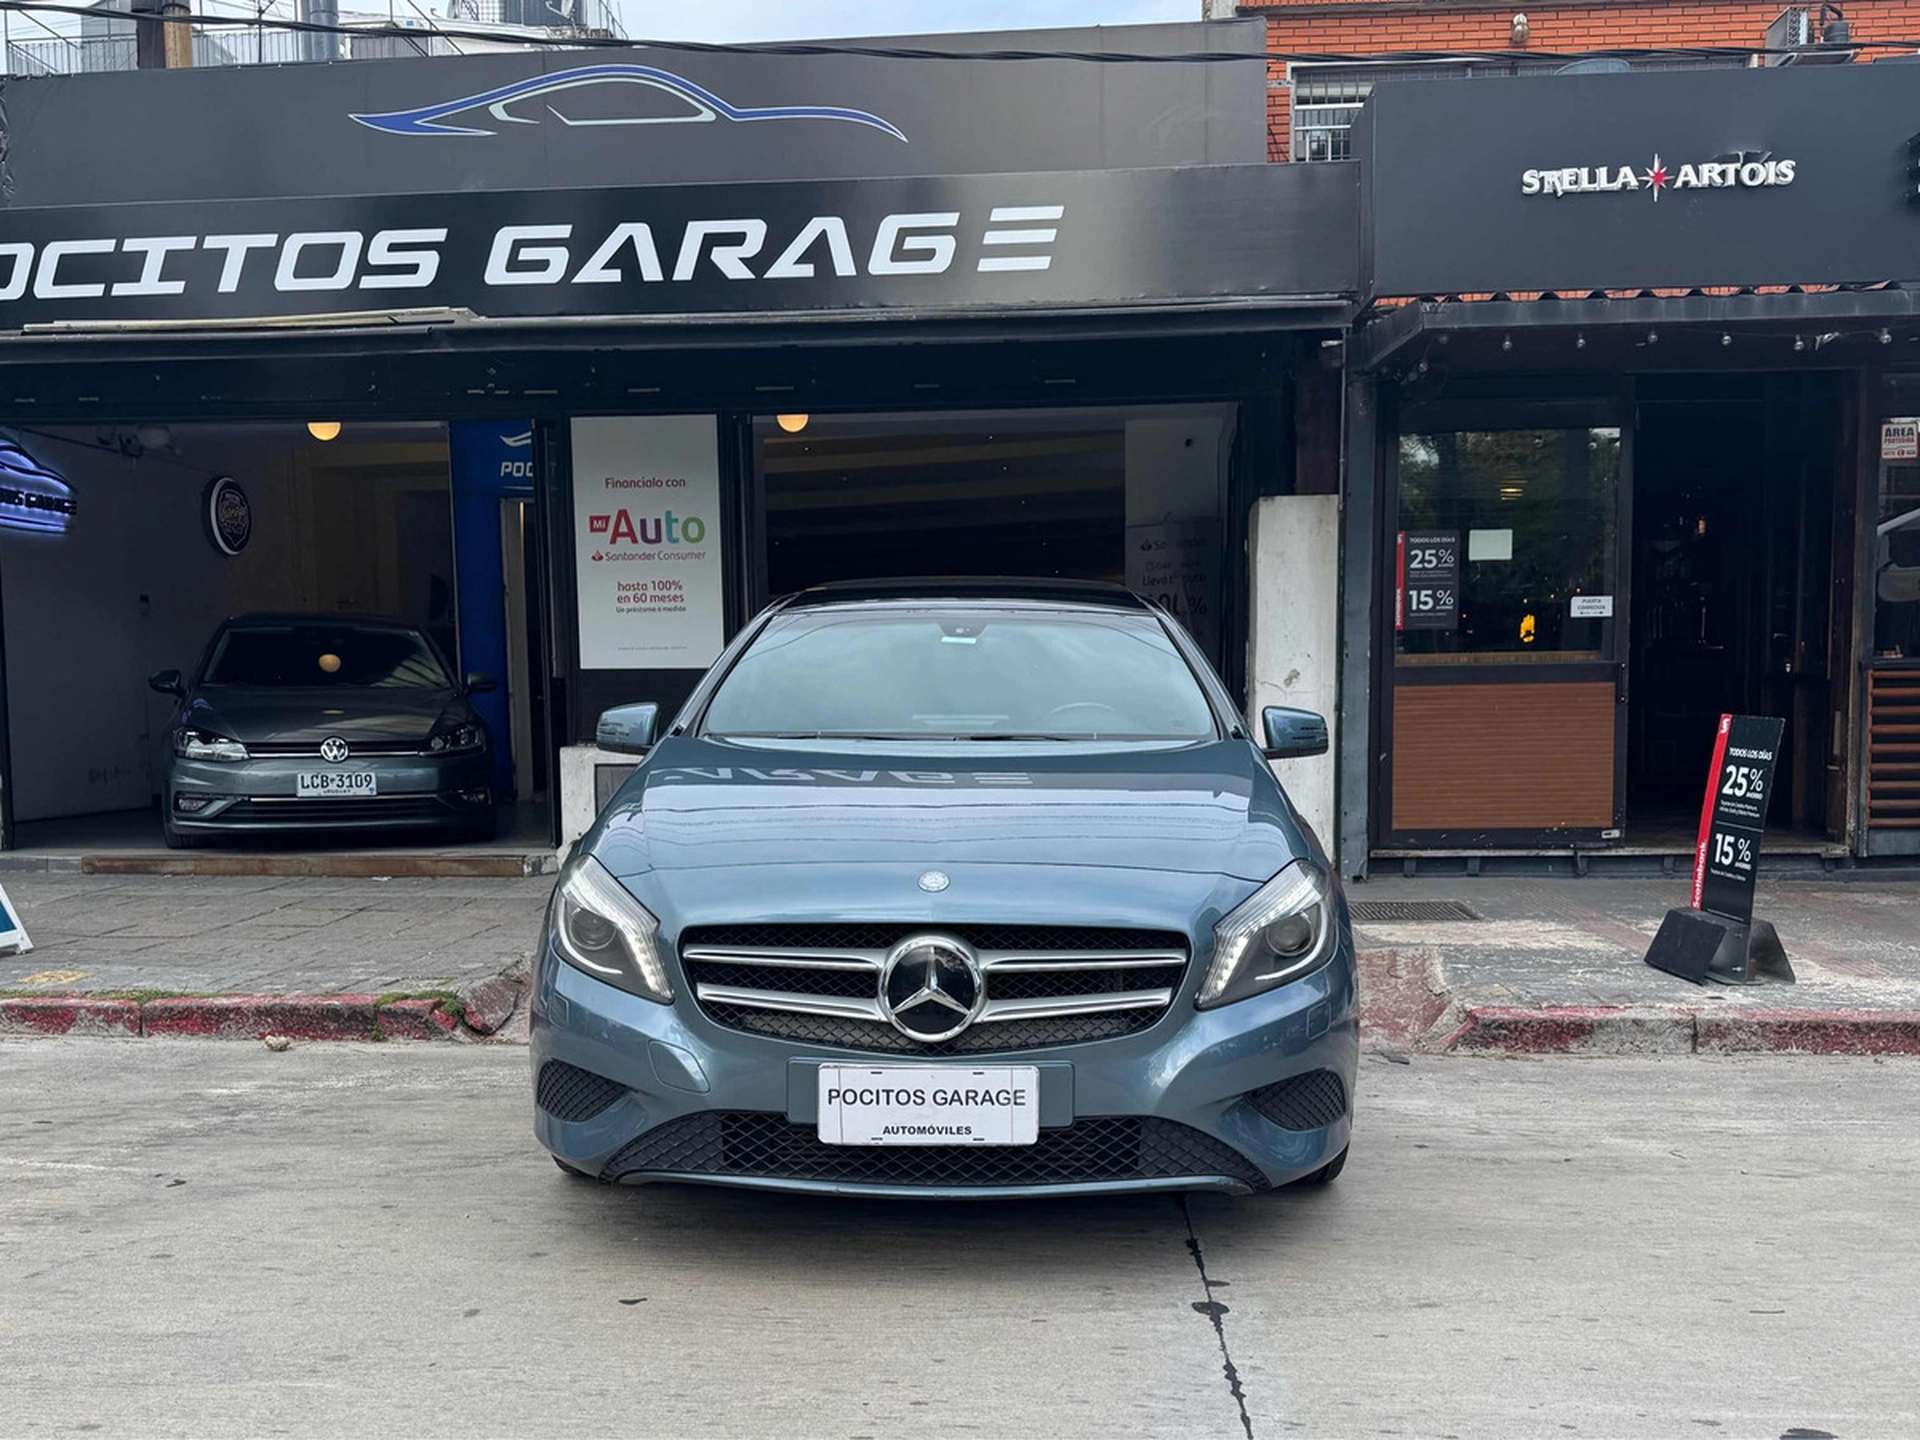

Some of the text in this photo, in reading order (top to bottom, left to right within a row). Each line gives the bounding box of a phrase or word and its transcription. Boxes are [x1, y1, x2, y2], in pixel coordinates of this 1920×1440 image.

[1522, 159, 1797, 196] STELLA ARTOIS
[484, 206, 1065, 286] GARAGE
[665, 478, 686, 487] con
[609, 508, 706, 545] Auto
[605, 550, 706, 562] Santander Consumer
[1409, 549, 1454, 568] 25%
[617, 580, 683, 591] hasta 100%
[617, 593, 685, 603] en 60 meses
[1409, 590, 1454, 610] 15%
[1722, 765, 1763, 797] 25%
[1714, 833, 1752, 866] 15%
[828, 1088, 1026, 1106] POCITOS GARAGE
[882, 1124, 973, 1136] AUTOMÓVILES
